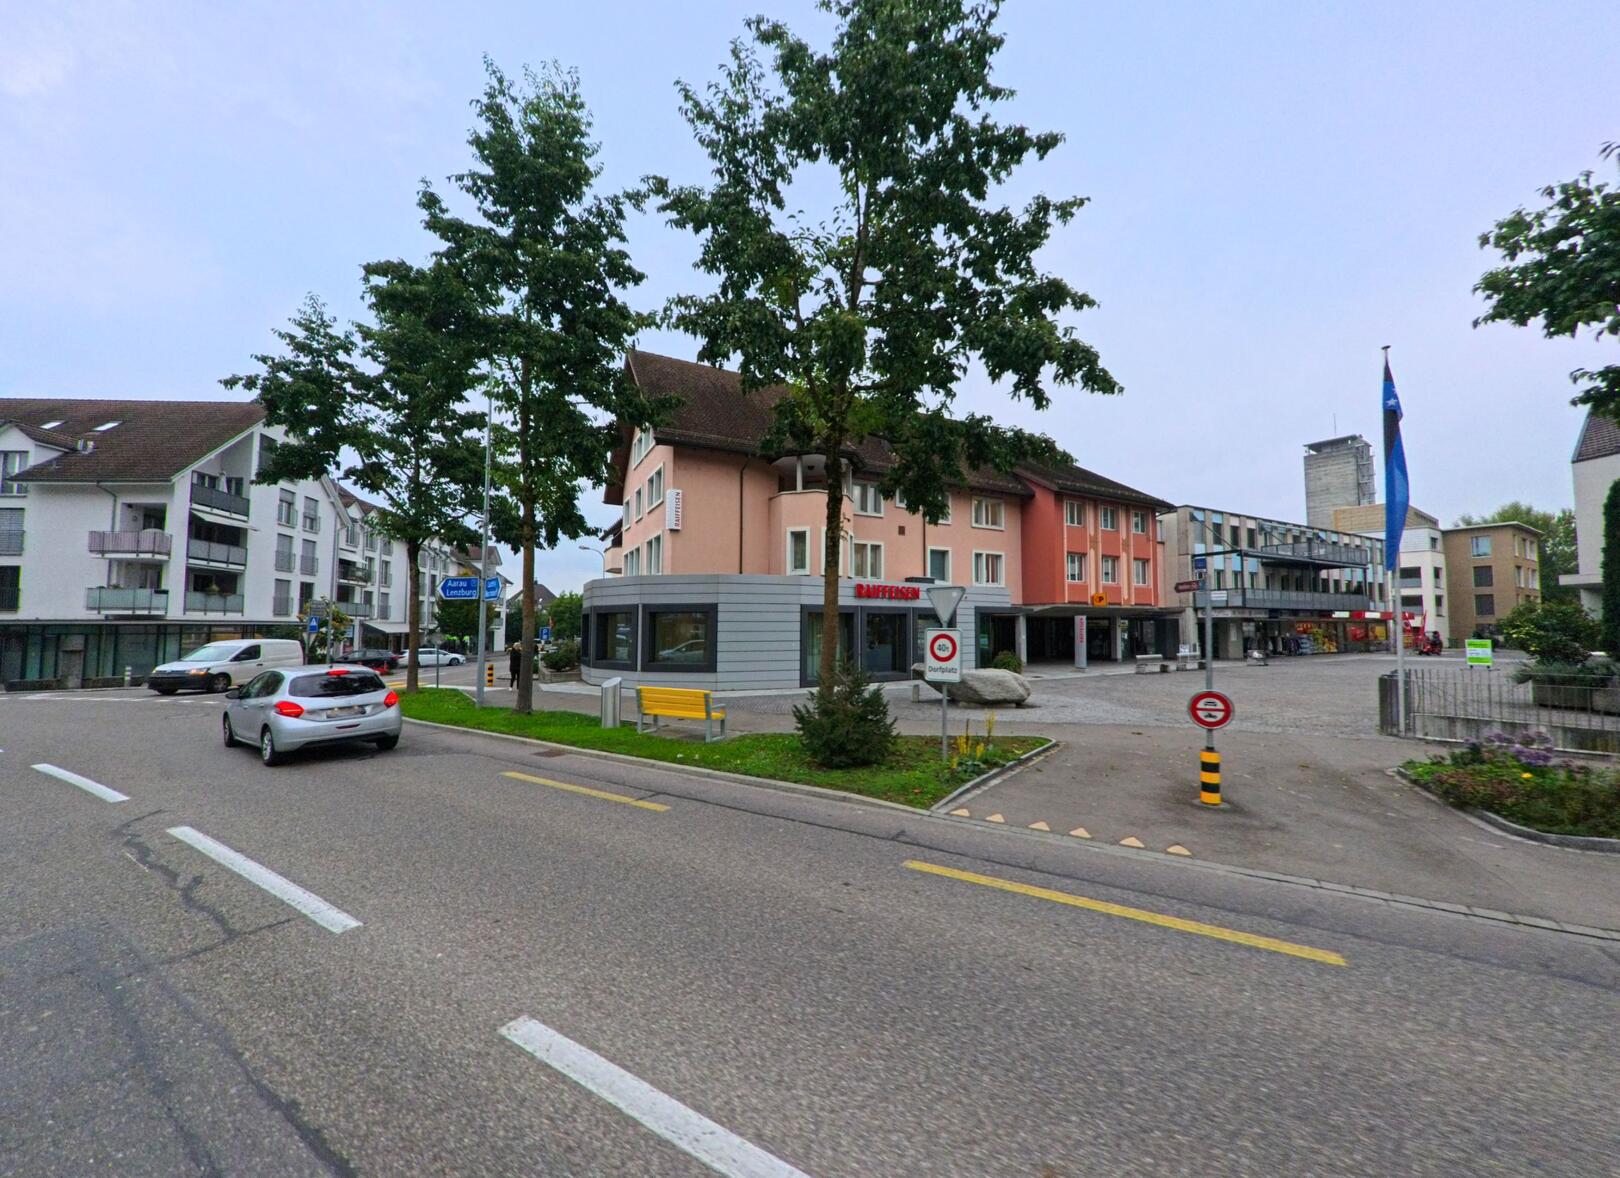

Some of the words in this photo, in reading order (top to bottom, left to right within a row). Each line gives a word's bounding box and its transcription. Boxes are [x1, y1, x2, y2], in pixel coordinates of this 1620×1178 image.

[446, 589, 477, 598] Lenzburg
[855, 583, 920, 600] RAIFFEISEN
[928, 665, 958, 674] Dorfplatz
